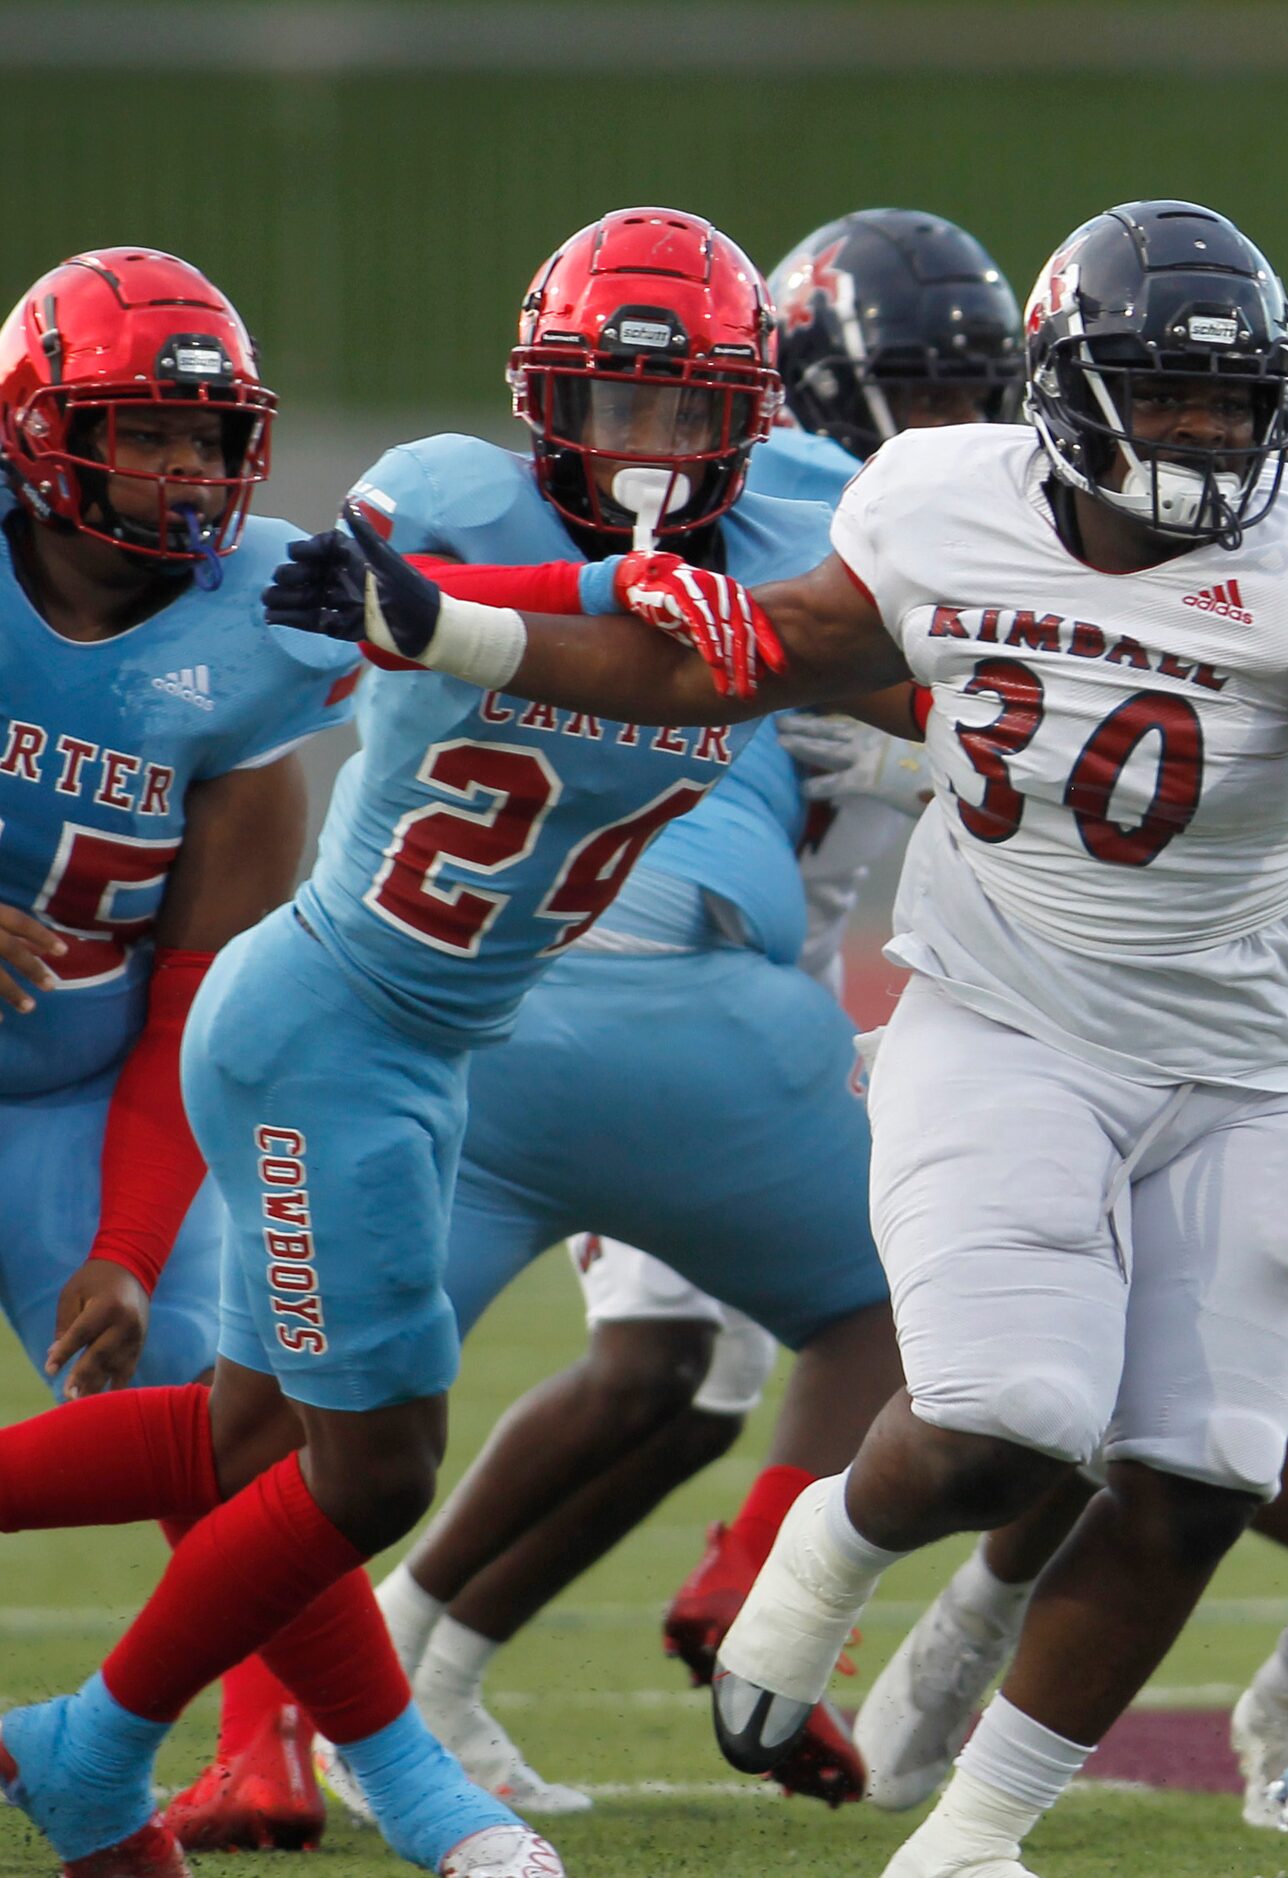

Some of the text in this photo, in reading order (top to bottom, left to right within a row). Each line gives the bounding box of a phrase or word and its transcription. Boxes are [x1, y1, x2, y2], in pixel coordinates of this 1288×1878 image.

[623, 327, 668, 342] schutt
[152, 672, 216, 711] adidas
[1182, 592, 1254, 626] adidas
[948, 656, 1205, 868] 30
[0, 818, 183, 990] 5
[362, 737, 718, 960] 24
[253, 1123, 329, 1356] COWBOYS
